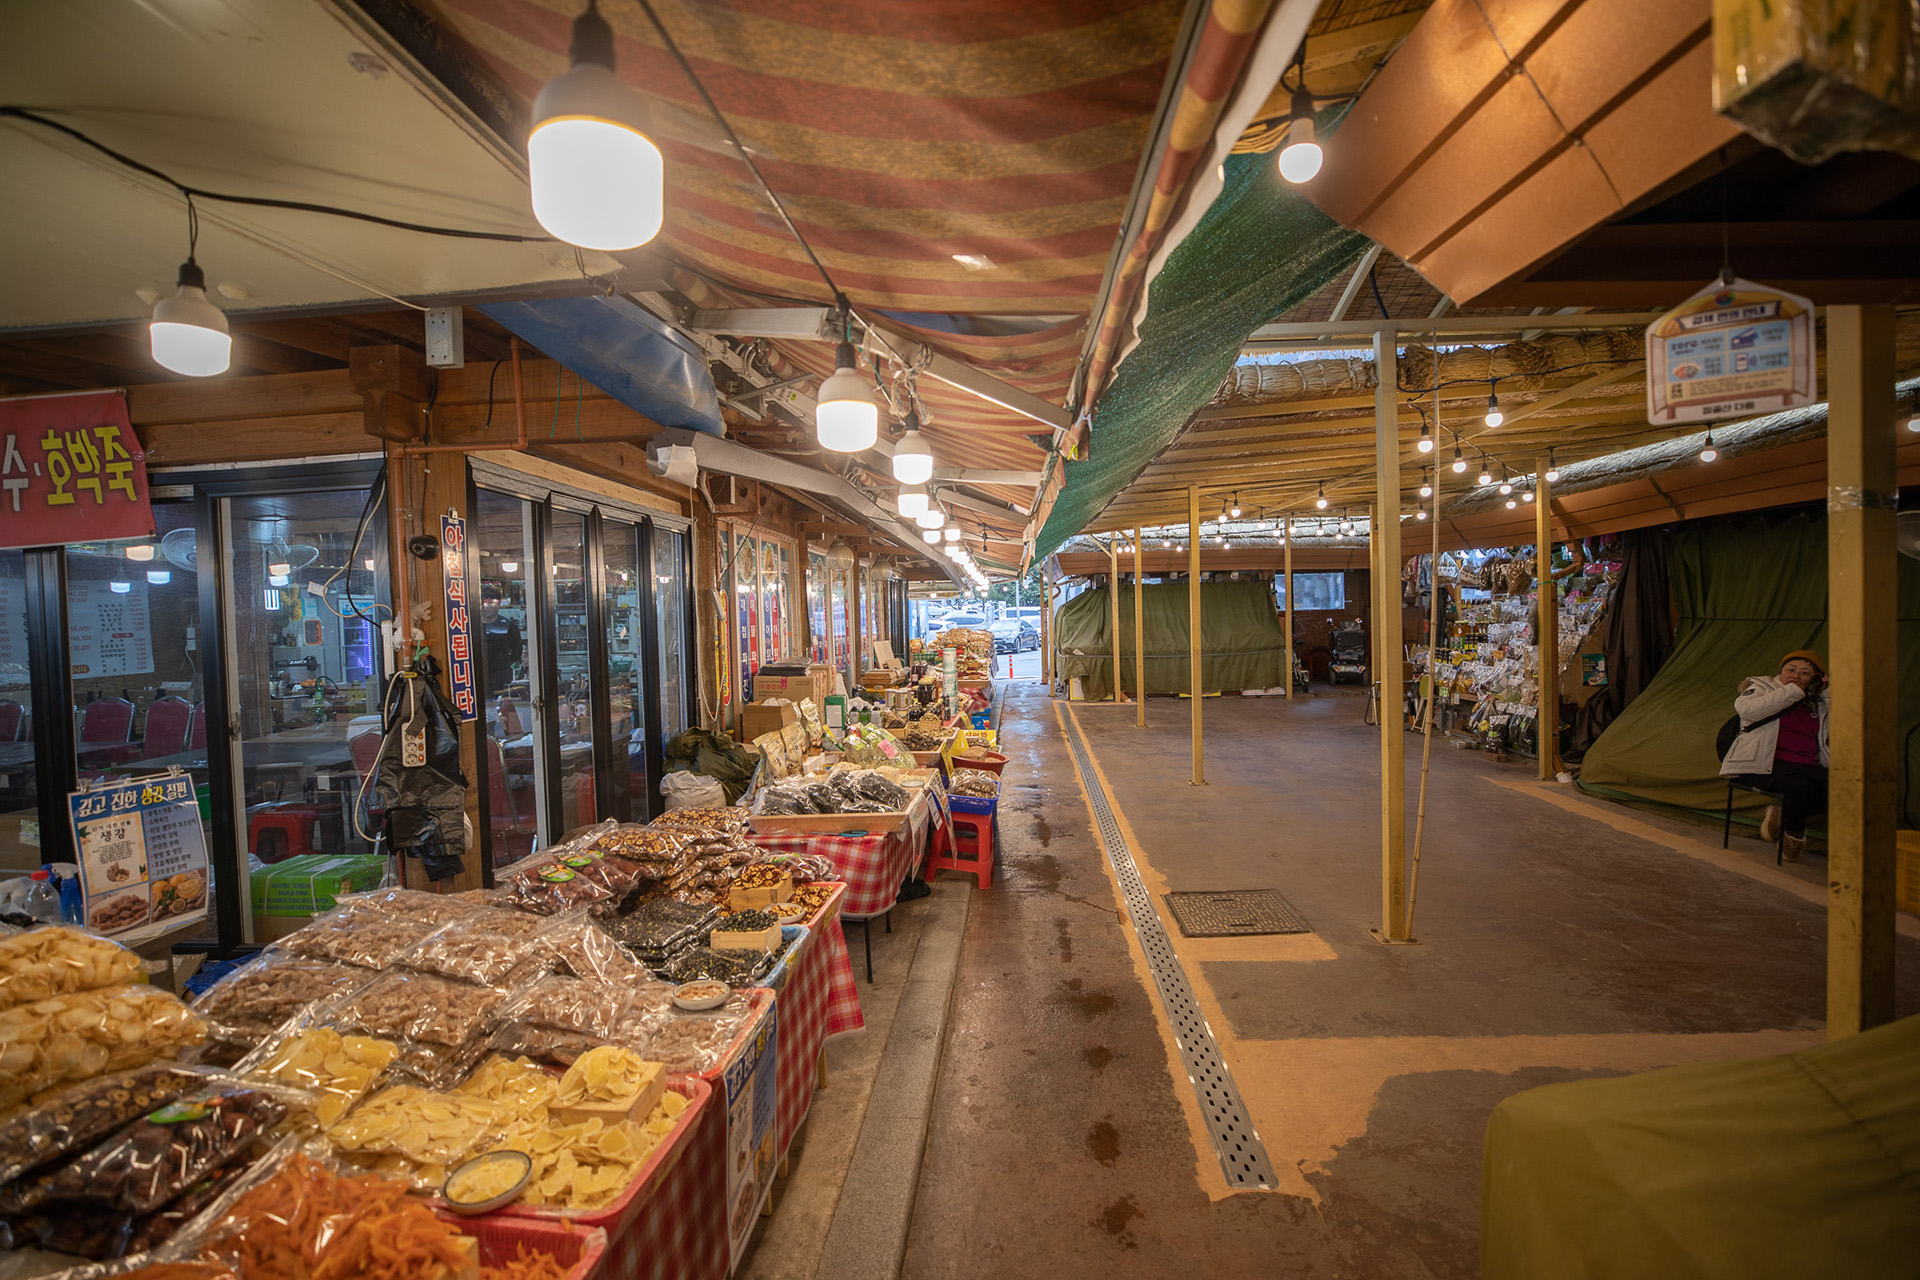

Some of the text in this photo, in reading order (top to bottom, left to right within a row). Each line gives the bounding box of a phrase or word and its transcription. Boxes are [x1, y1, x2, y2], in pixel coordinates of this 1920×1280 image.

[41, 426, 137, 505] 호박죽
[444, 525, 473, 715] 아침식사됩니다
[78, 781, 188, 817] 깊고 진한 생강 절편
[100, 828, 126, 842] 생강
